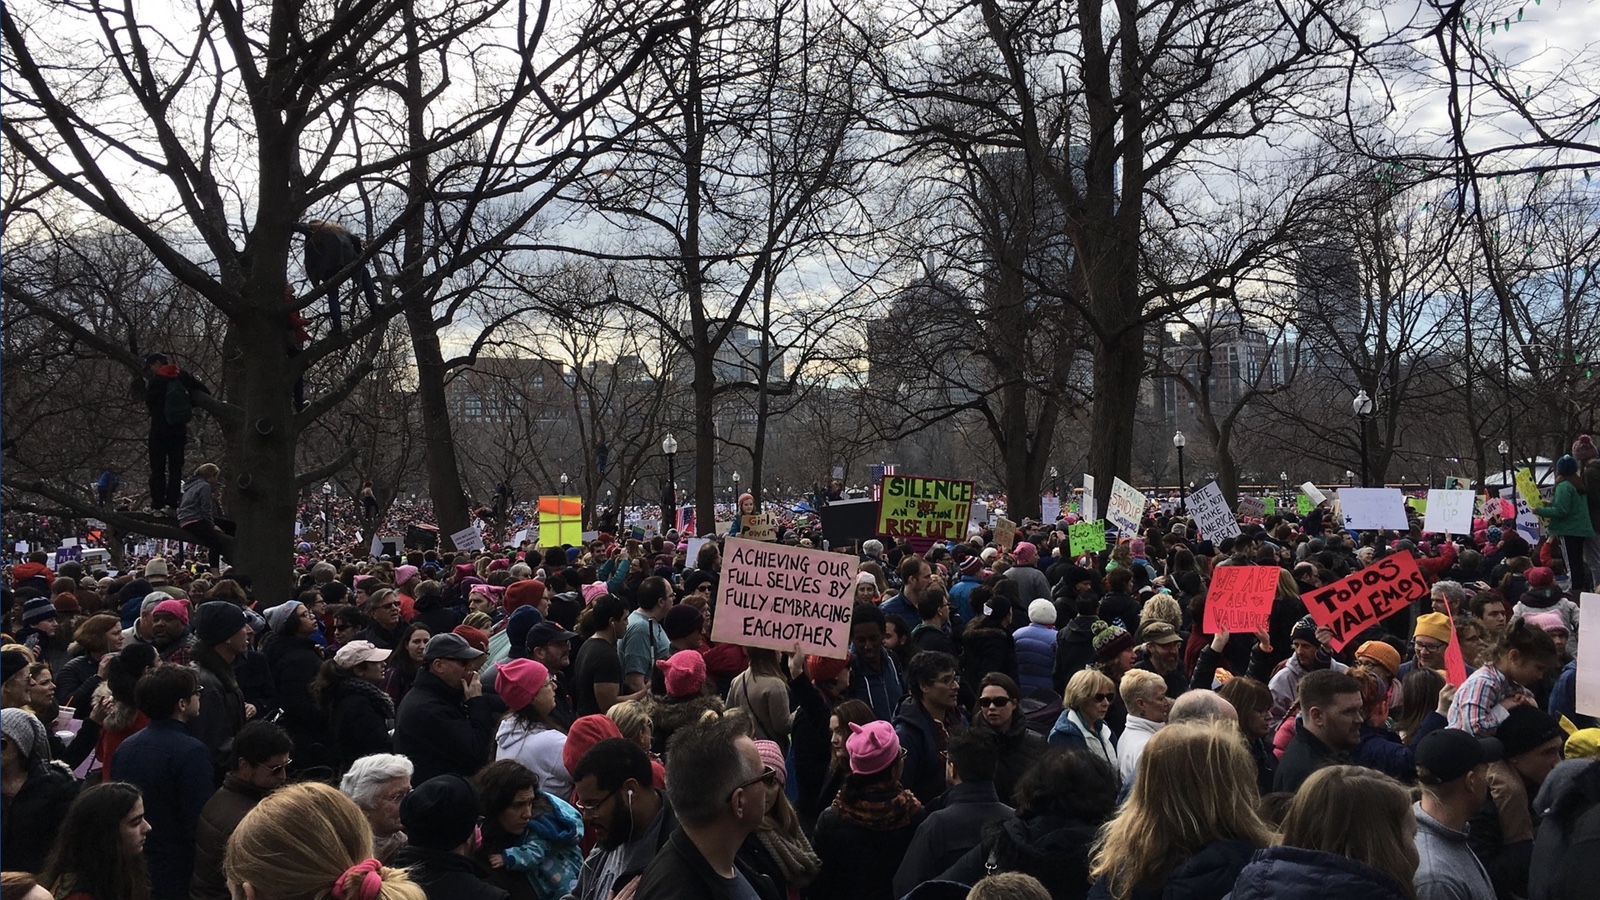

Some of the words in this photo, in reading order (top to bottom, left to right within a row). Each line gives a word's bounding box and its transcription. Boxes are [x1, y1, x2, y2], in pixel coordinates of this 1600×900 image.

[888, 477, 970, 502] SILENCE
[1191, 487, 1212, 505] HATE
[1436, 491, 1463, 507] ACT
[891, 508, 908, 517] AN
[916, 509, 952, 519] OPTION
[905, 500, 916, 508] IS
[917, 500, 938, 511] NOT
[1190, 502, 1208, 517] DOES
[1209, 493, 1224, 507] NOT
[1201, 506, 1223, 525] MAKE
[1443, 508, 1458, 522] UP
[742, 525, 771, 537] Power
[886, 518, 922, 537] RISE
[1201, 511, 1235, 536] AMERICA
[1210, 522, 1238, 545] GREAT
[58, 555, 76, 563] PITY
[731, 547, 810, 574] ACHIEVING
[817, 560, 852, 580] OUR
[728, 568, 762, 587] FULL
[766, 571, 821, 594] SELVES
[828, 580, 851, 599] BY
[1216, 567, 1240, 591] WE
[1241, 566, 1279, 593] ARE
[725, 588, 769, 611] FULLY
[772, 597, 852, 623] EMBRACING
[1226, 592, 1248, 608] ALL
[1326, 571, 1426, 643] VALEMOS
[1213, 606, 1270, 631] VALUABLE
[743, 616, 837, 648] EACHOTHER
